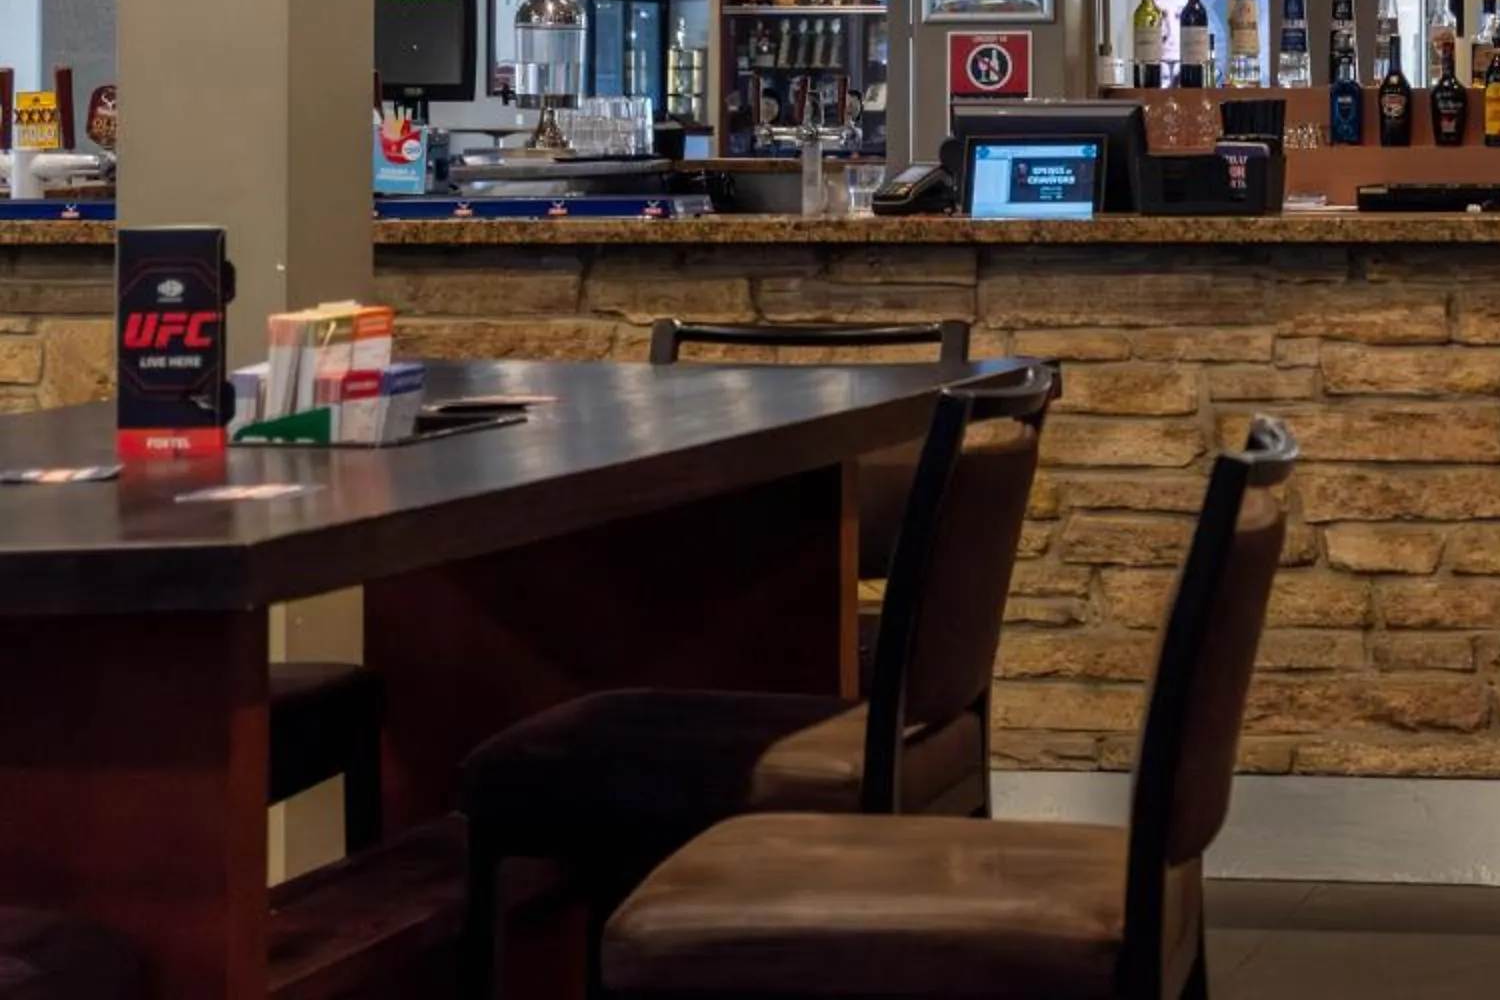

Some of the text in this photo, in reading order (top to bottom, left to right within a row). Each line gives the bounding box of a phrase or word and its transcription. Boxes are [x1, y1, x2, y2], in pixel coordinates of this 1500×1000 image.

[123, 311, 222, 349] UFC
[138, 355, 202, 370] LIVE HERE
